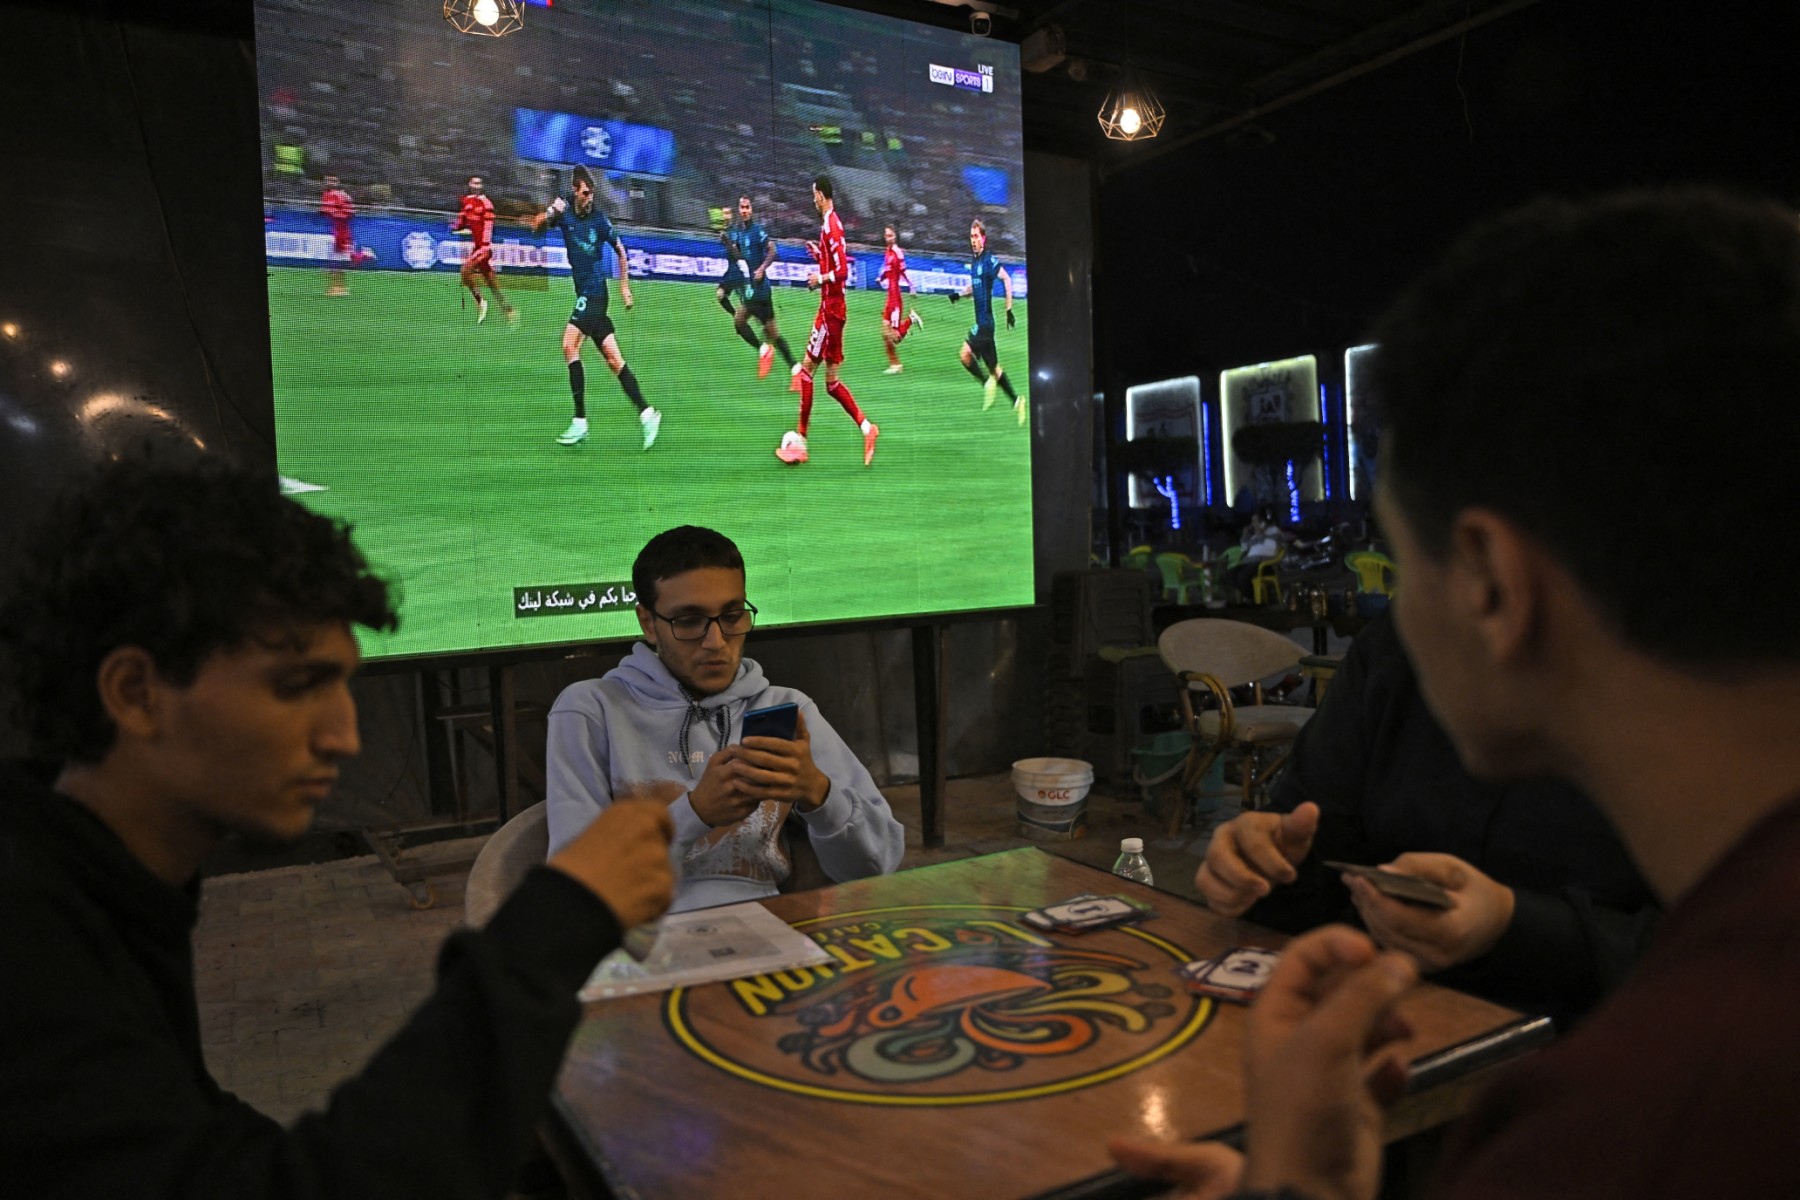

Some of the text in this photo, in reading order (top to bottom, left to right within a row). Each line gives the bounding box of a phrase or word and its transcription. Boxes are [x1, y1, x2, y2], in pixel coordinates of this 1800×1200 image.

[977, 64, 994, 76] LIVE
[955, 73, 981, 88] SPORTS
[518, 586, 640, 611] حبا بكم في شبكة لينك
[1047, 790, 1071, 800] GLC
[812, 922, 881, 943] CAFE
